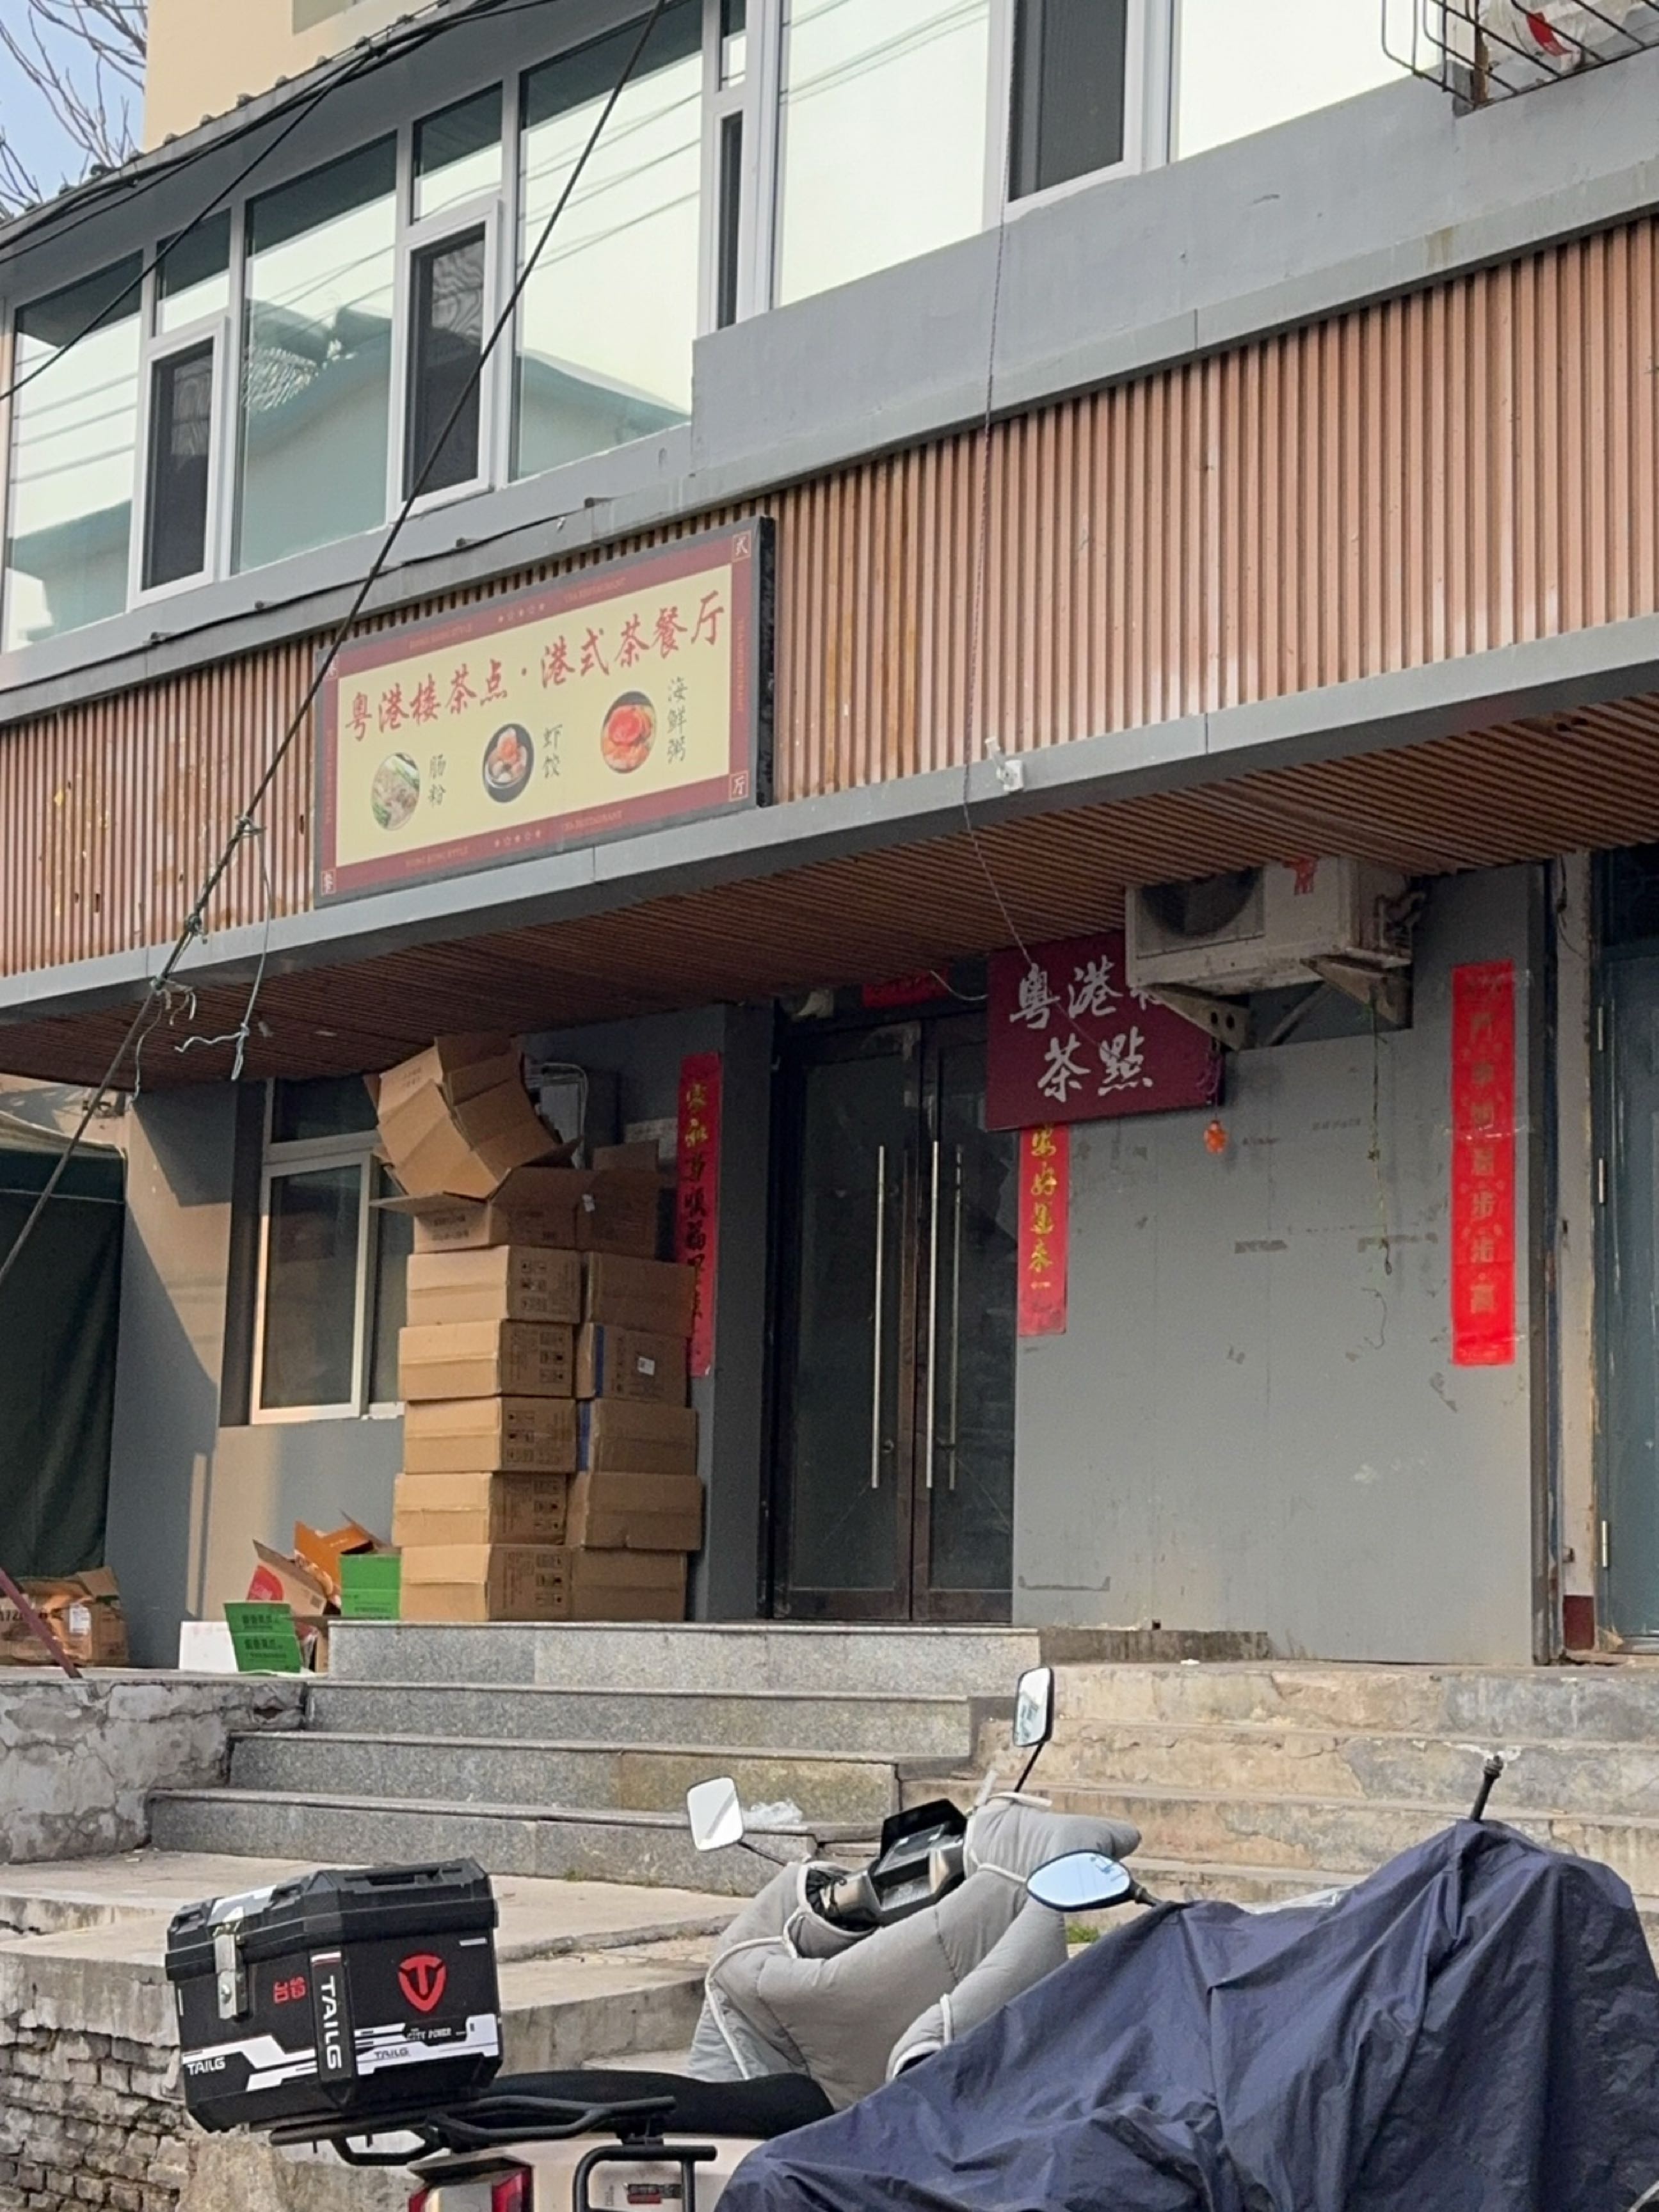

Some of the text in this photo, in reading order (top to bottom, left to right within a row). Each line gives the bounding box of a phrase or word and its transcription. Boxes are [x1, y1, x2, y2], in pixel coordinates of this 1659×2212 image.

[667, 676, 689, 764] 海鲜粥
[542, 724, 563, 778] 虾饺
[319, 1975, 344, 2070] TAILG
[186, 2055, 227, 2076] TAILG
[373, 2046, 411, 2059] TAILG
